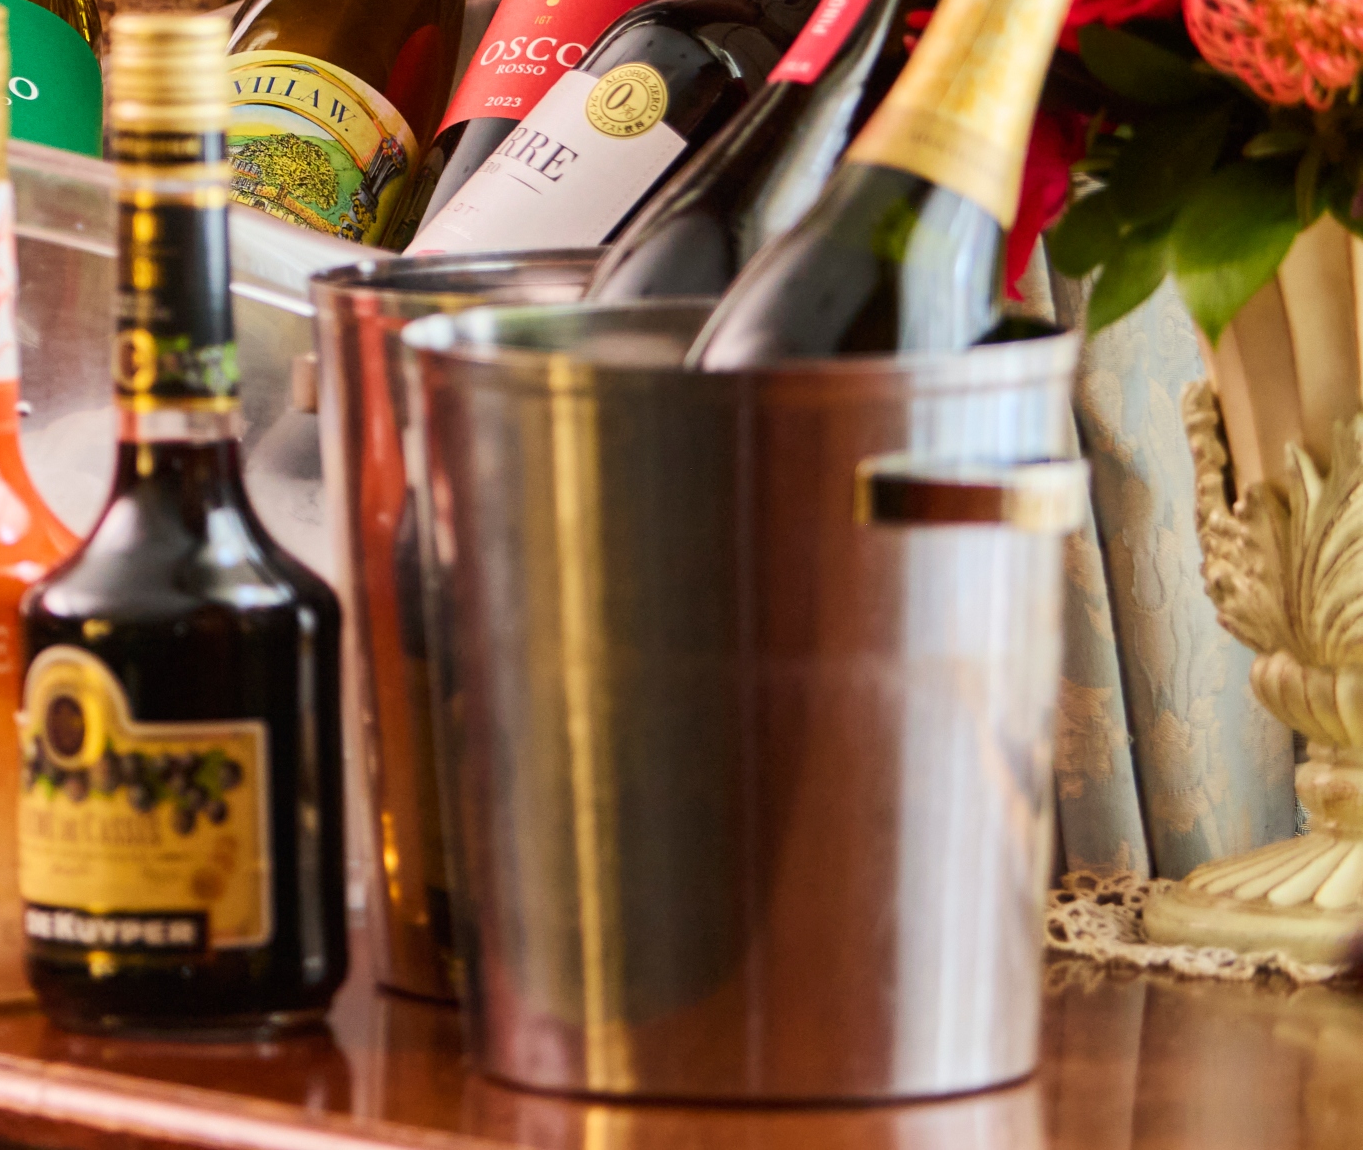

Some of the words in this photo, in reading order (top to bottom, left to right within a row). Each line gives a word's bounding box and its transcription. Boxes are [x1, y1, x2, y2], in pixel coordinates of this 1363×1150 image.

[535, 15, 553, 25] IGT
[480, 36, 588, 68] OSCO
[495, 63, 546, 76] ROSSO
[234, 76, 320, 109] VILLA
[605, 69, 651, 85] ALCOHOL
[648, 83, 661, 112] ZERO
[484, 96, 522, 108] 2023
